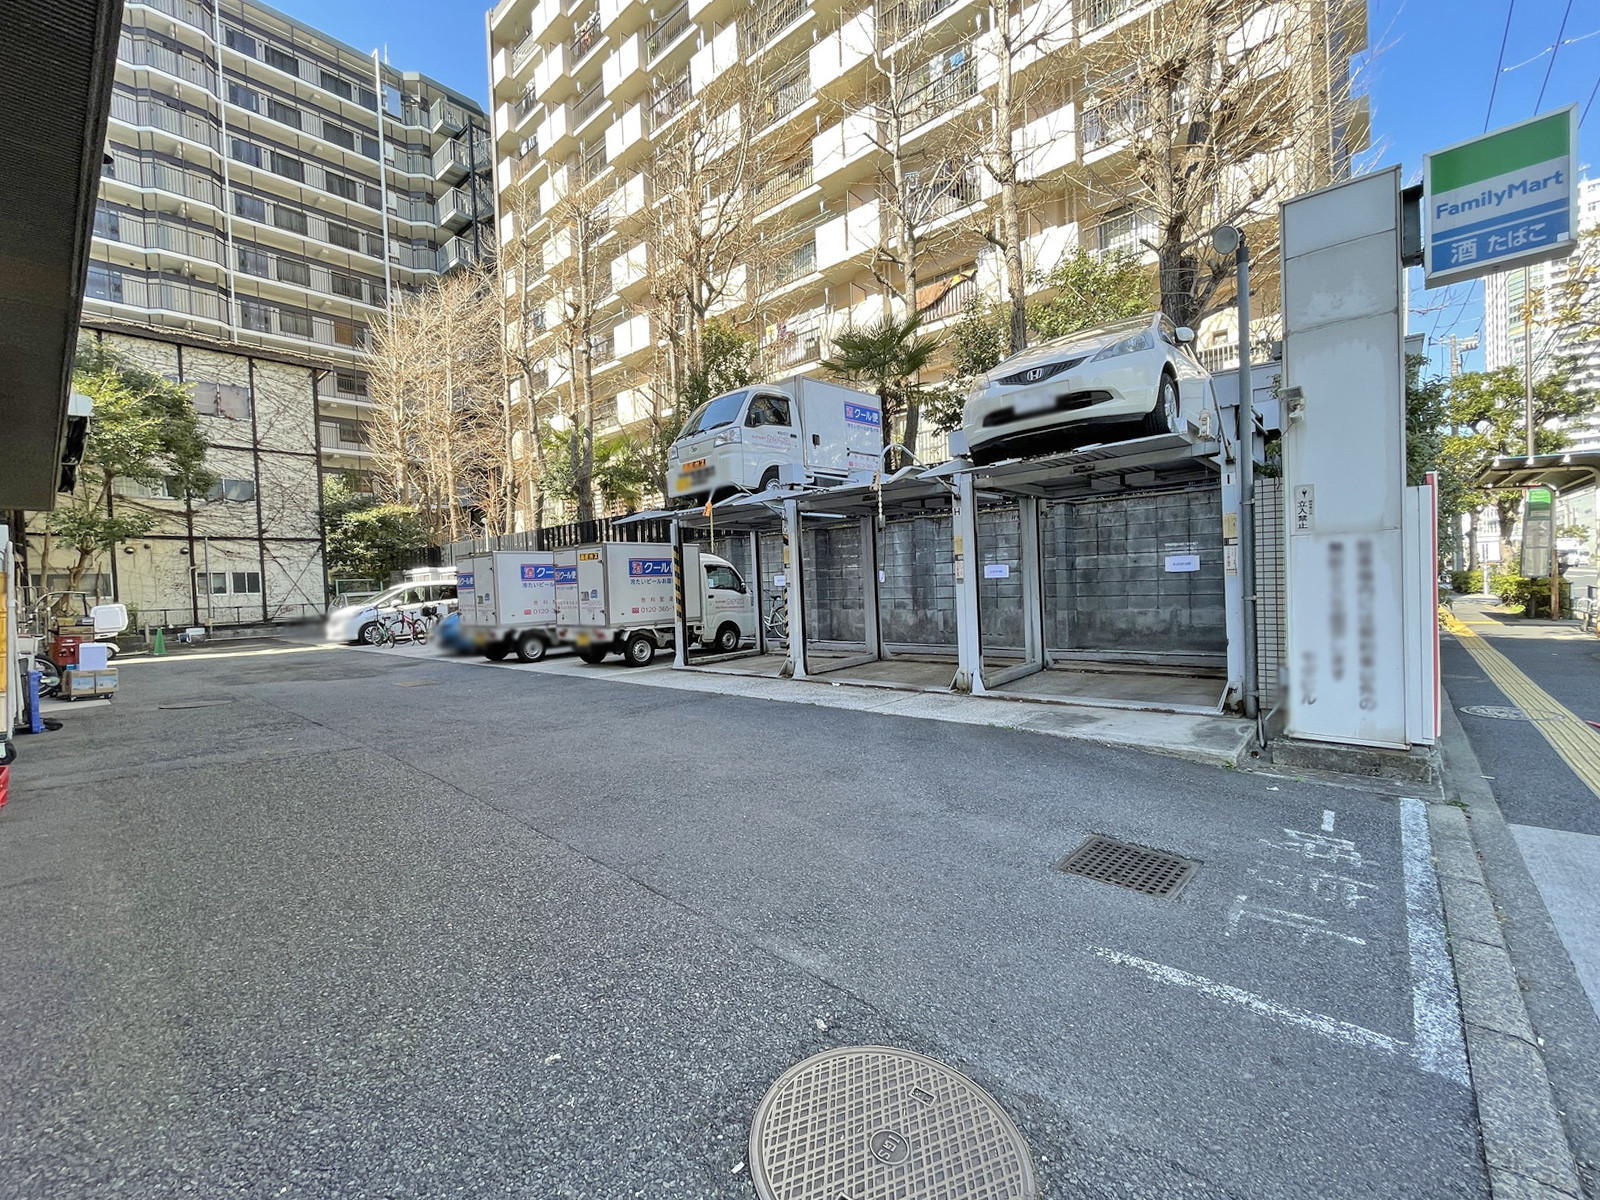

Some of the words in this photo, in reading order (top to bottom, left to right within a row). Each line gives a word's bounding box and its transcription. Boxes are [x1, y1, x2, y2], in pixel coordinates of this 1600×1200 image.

[1436, 170, 1564, 220] FamilyMart
[1451, 238, 1478, 264] 酒
[1487, 222, 1548, 253] たばこ
[1297, 500, 1309, 529] 立入禁止
